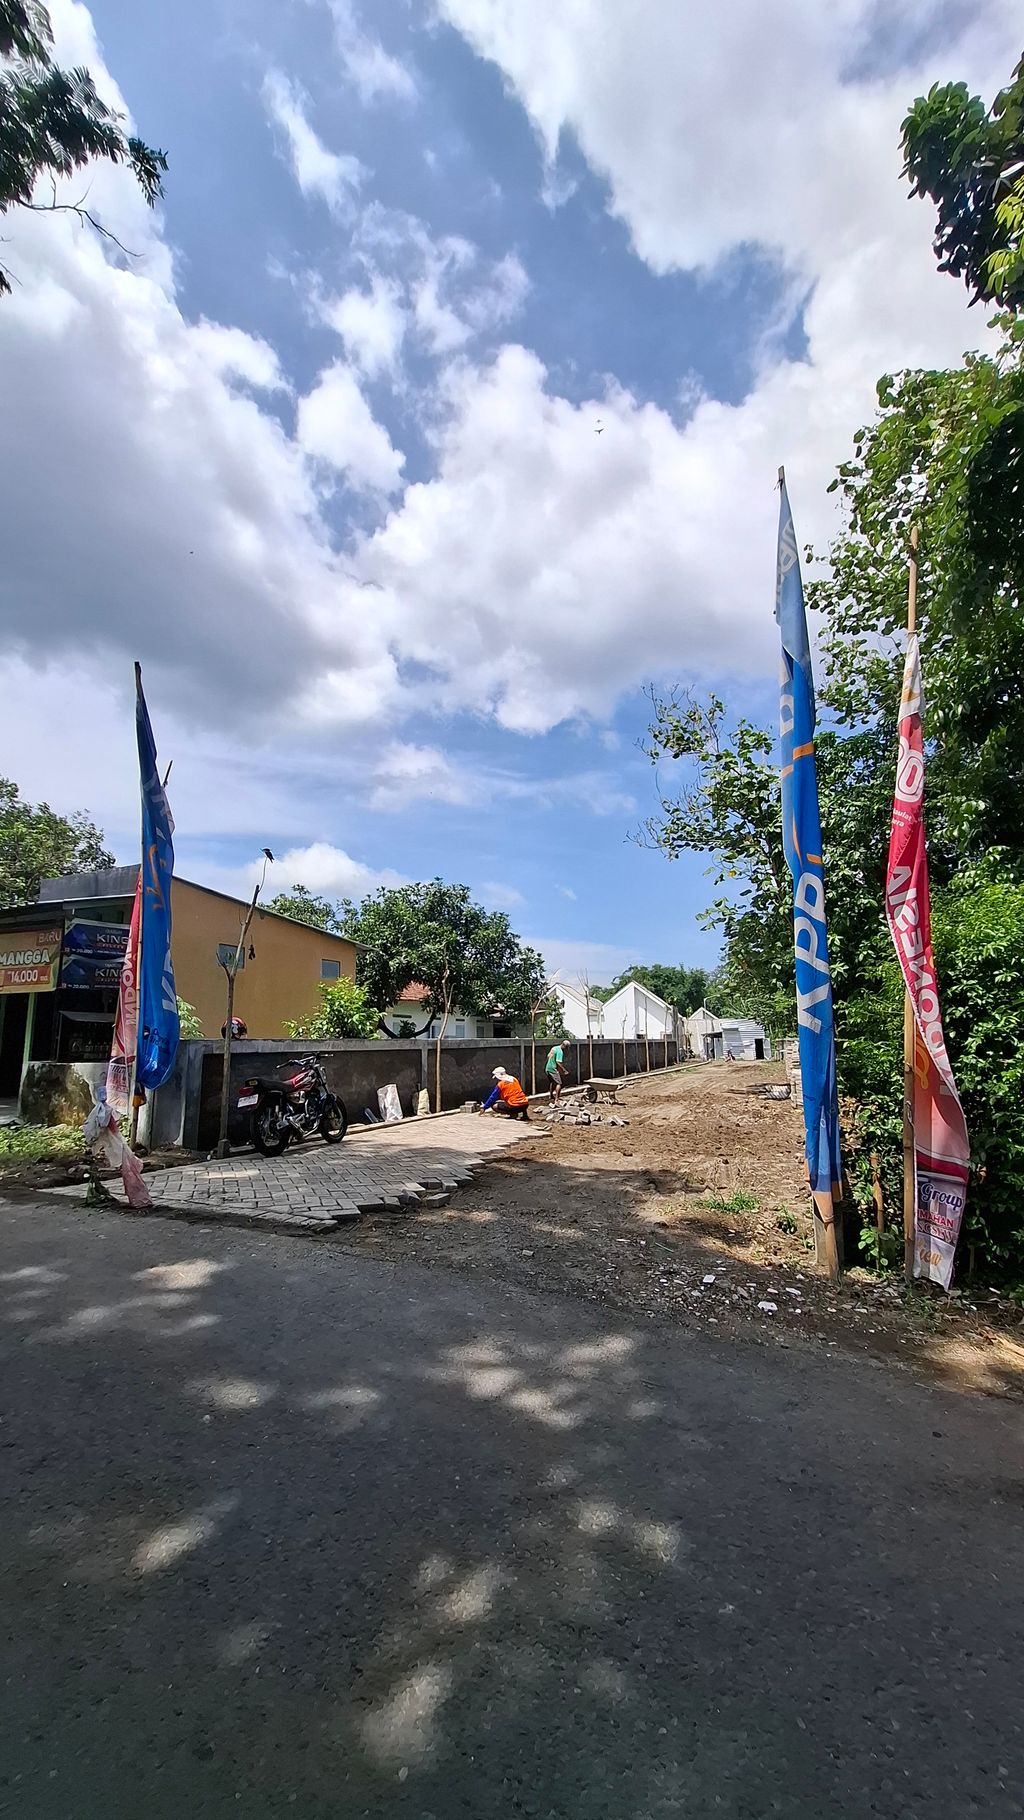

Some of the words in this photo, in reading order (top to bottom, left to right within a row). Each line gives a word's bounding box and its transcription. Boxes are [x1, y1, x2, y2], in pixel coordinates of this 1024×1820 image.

[96, 933, 129, 945] KING
[0, 949, 50, 966] MANGGA
[95, 968, 122, 977] KIN
[921, 1183, 963, 1211] Group
